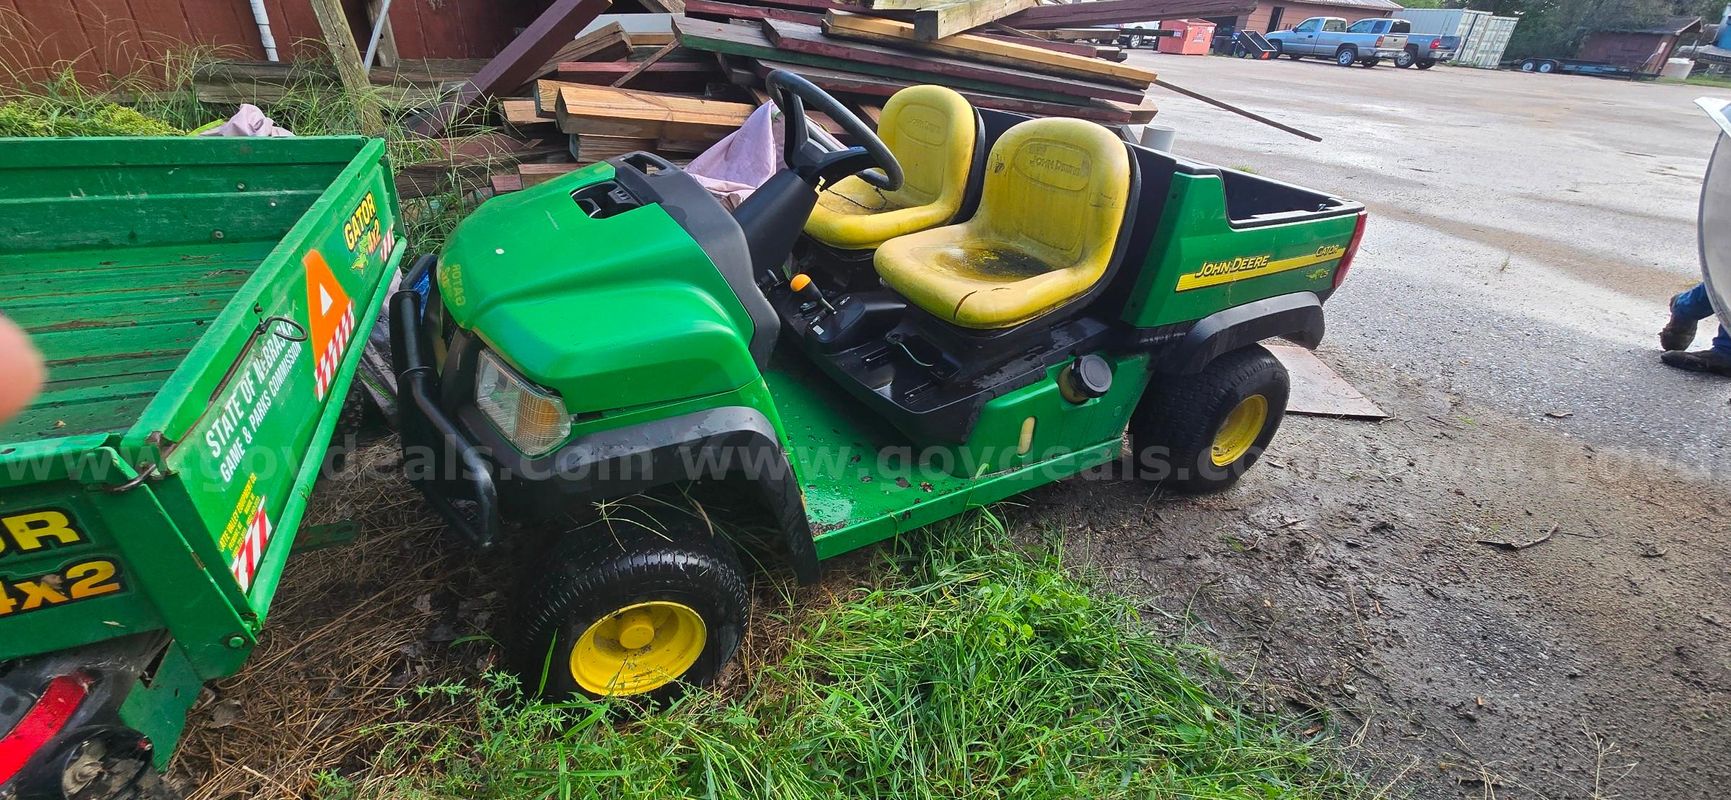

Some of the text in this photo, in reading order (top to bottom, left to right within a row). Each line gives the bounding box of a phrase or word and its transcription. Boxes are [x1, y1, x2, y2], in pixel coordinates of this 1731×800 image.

[344, 191, 376, 251] GATOR
[1195, 255, 1270, 278] JOHN DEERE
[205, 392, 245, 458] STATE
[240, 371, 256, 404] OF
[220, 437, 246, 483] GAME
[242, 426, 253, 444] &
[248, 390, 272, 433] PARKS
[268, 341, 302, 397] COMMISSION
[0, 511, 80, 553] R
